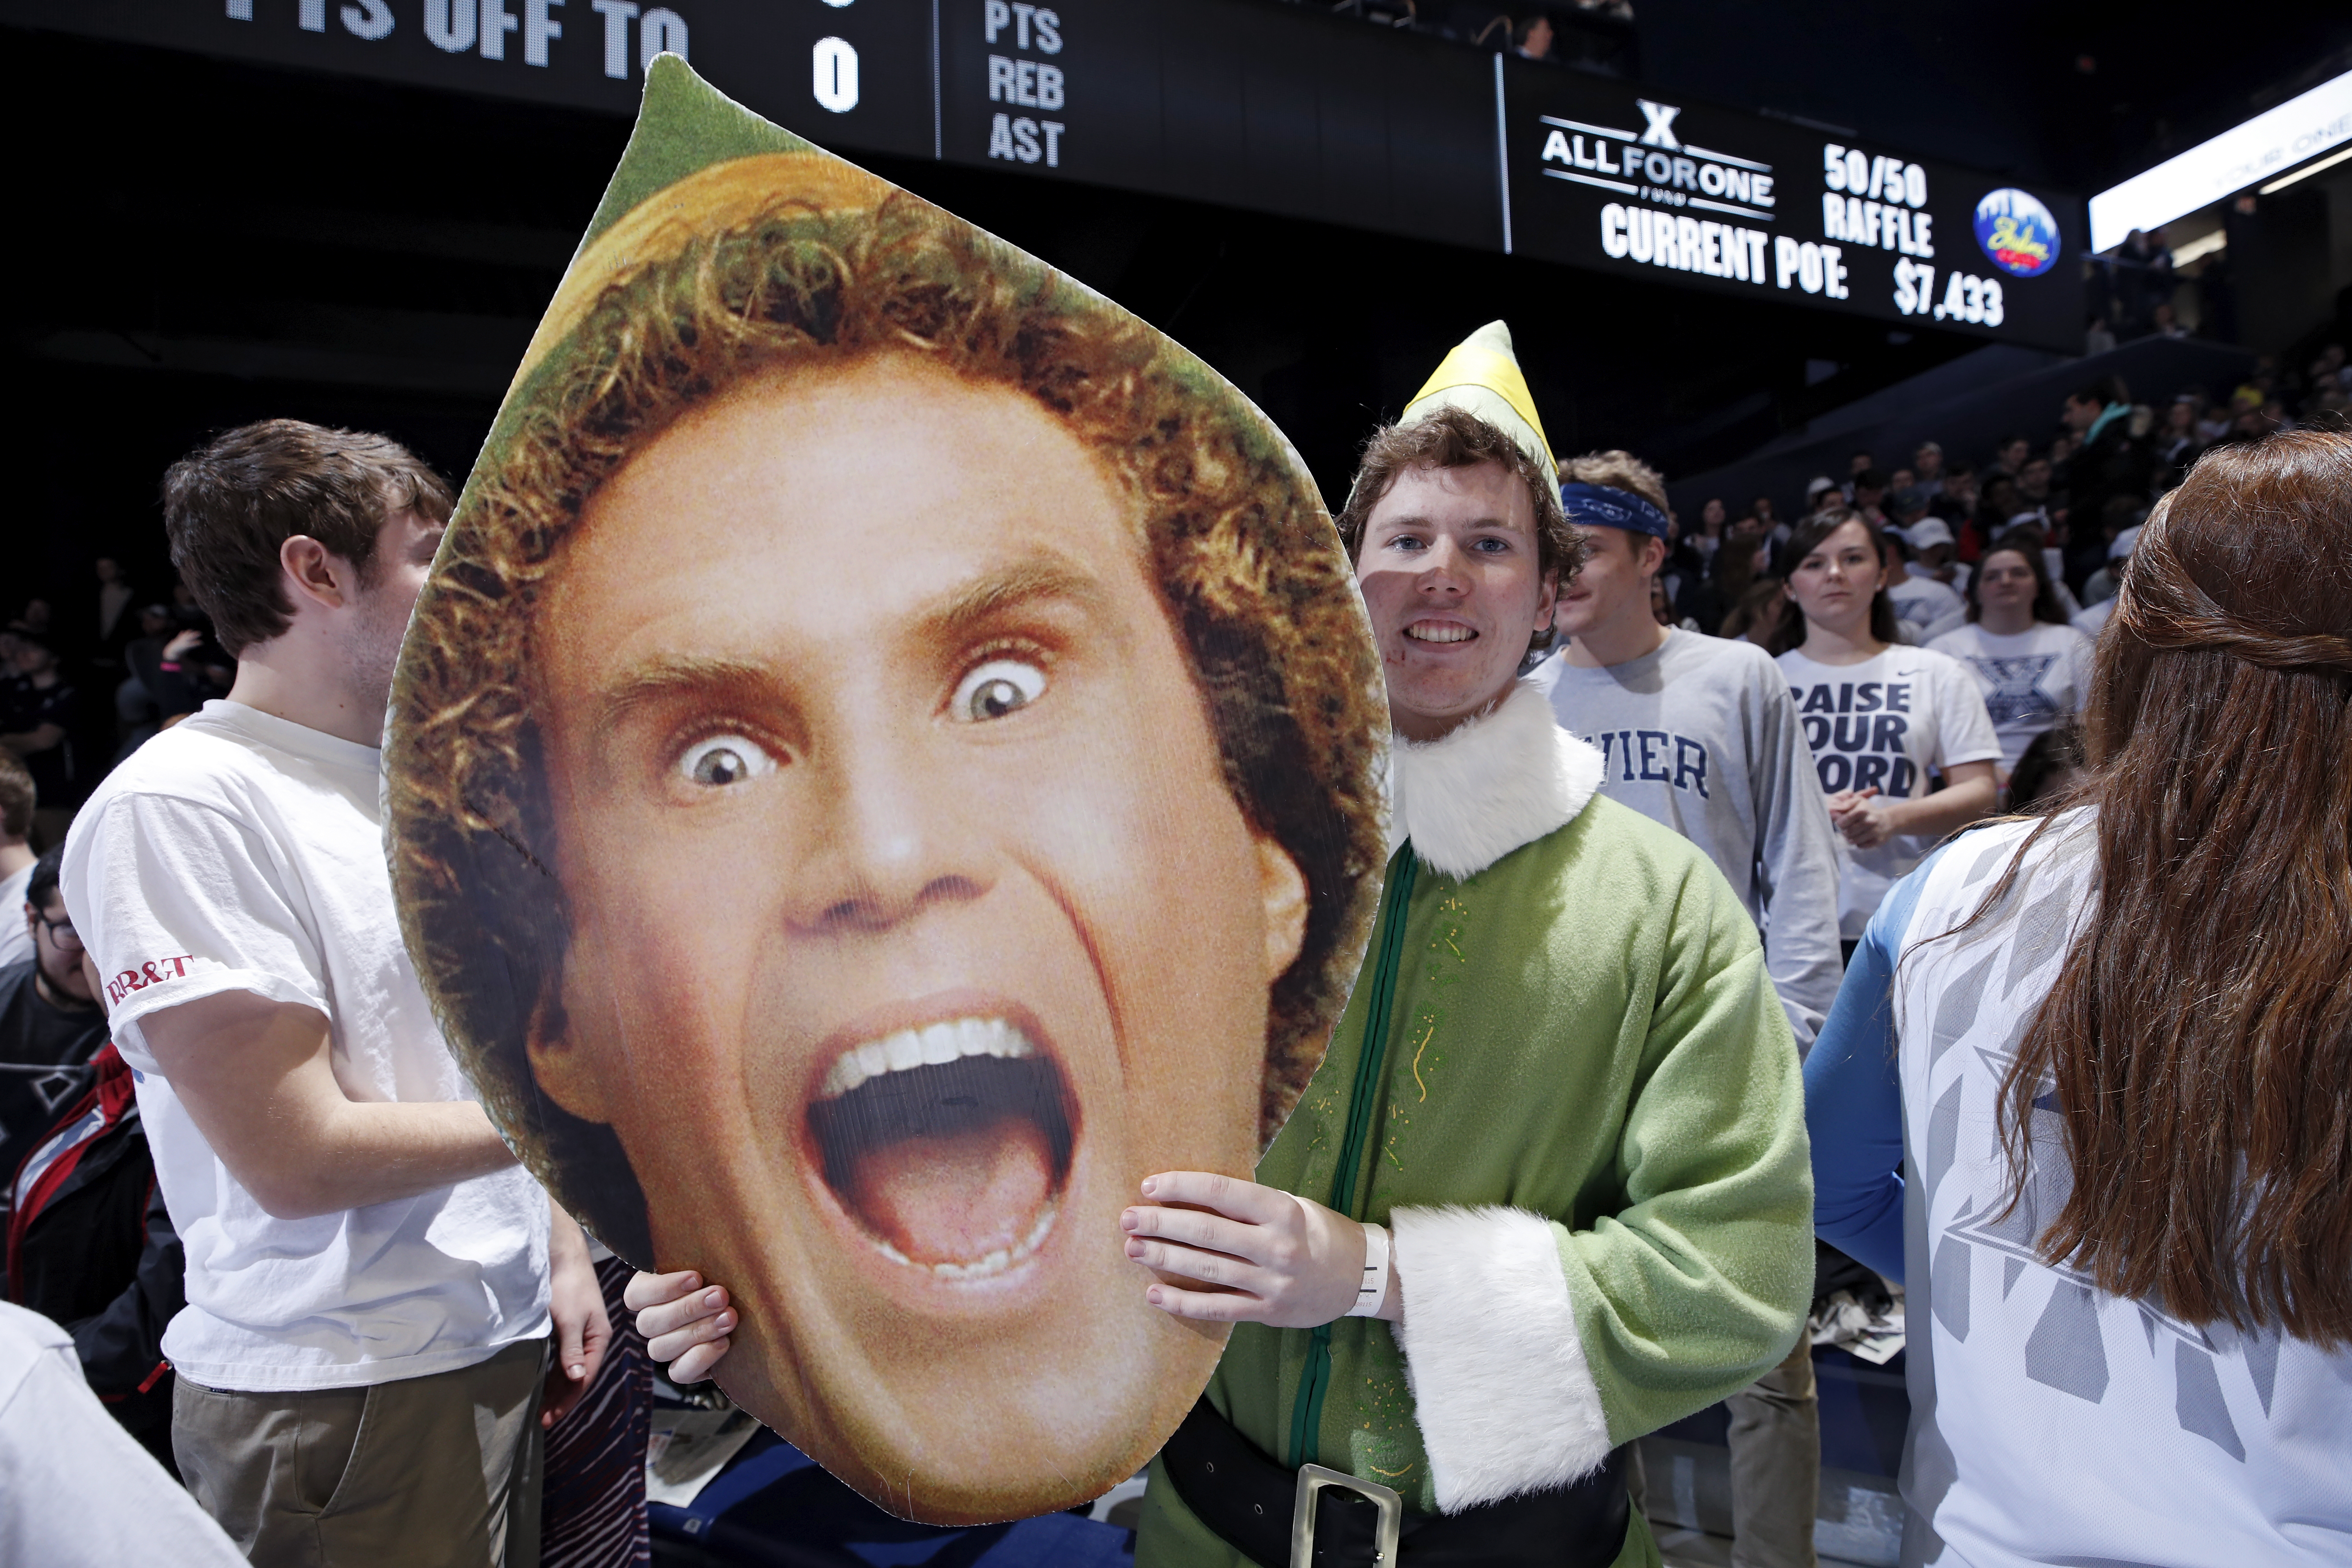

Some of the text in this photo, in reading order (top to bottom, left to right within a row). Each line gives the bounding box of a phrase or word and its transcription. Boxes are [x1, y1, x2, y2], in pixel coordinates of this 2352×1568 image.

[592, 0, 688, 80] TO
[985, 0, 1063, 54] PTS
[813, 36, 859, 113] 0
[989, 54, 1064, 111] REB
[988, 113, 1065, 167] AST
[1636, 98, 1683, 152] X
[1824, 143, 1928, 208] 50/50
[1823, 192, 1934, 258] RAFFLE
[1601, 203, 2004, 327] CURRENT POT: $7,433
[1575, 728, 1710, 800] VIER
[1801, 715, 1907, 753] OUR
[1813, 754, 1916, 797] ORD
